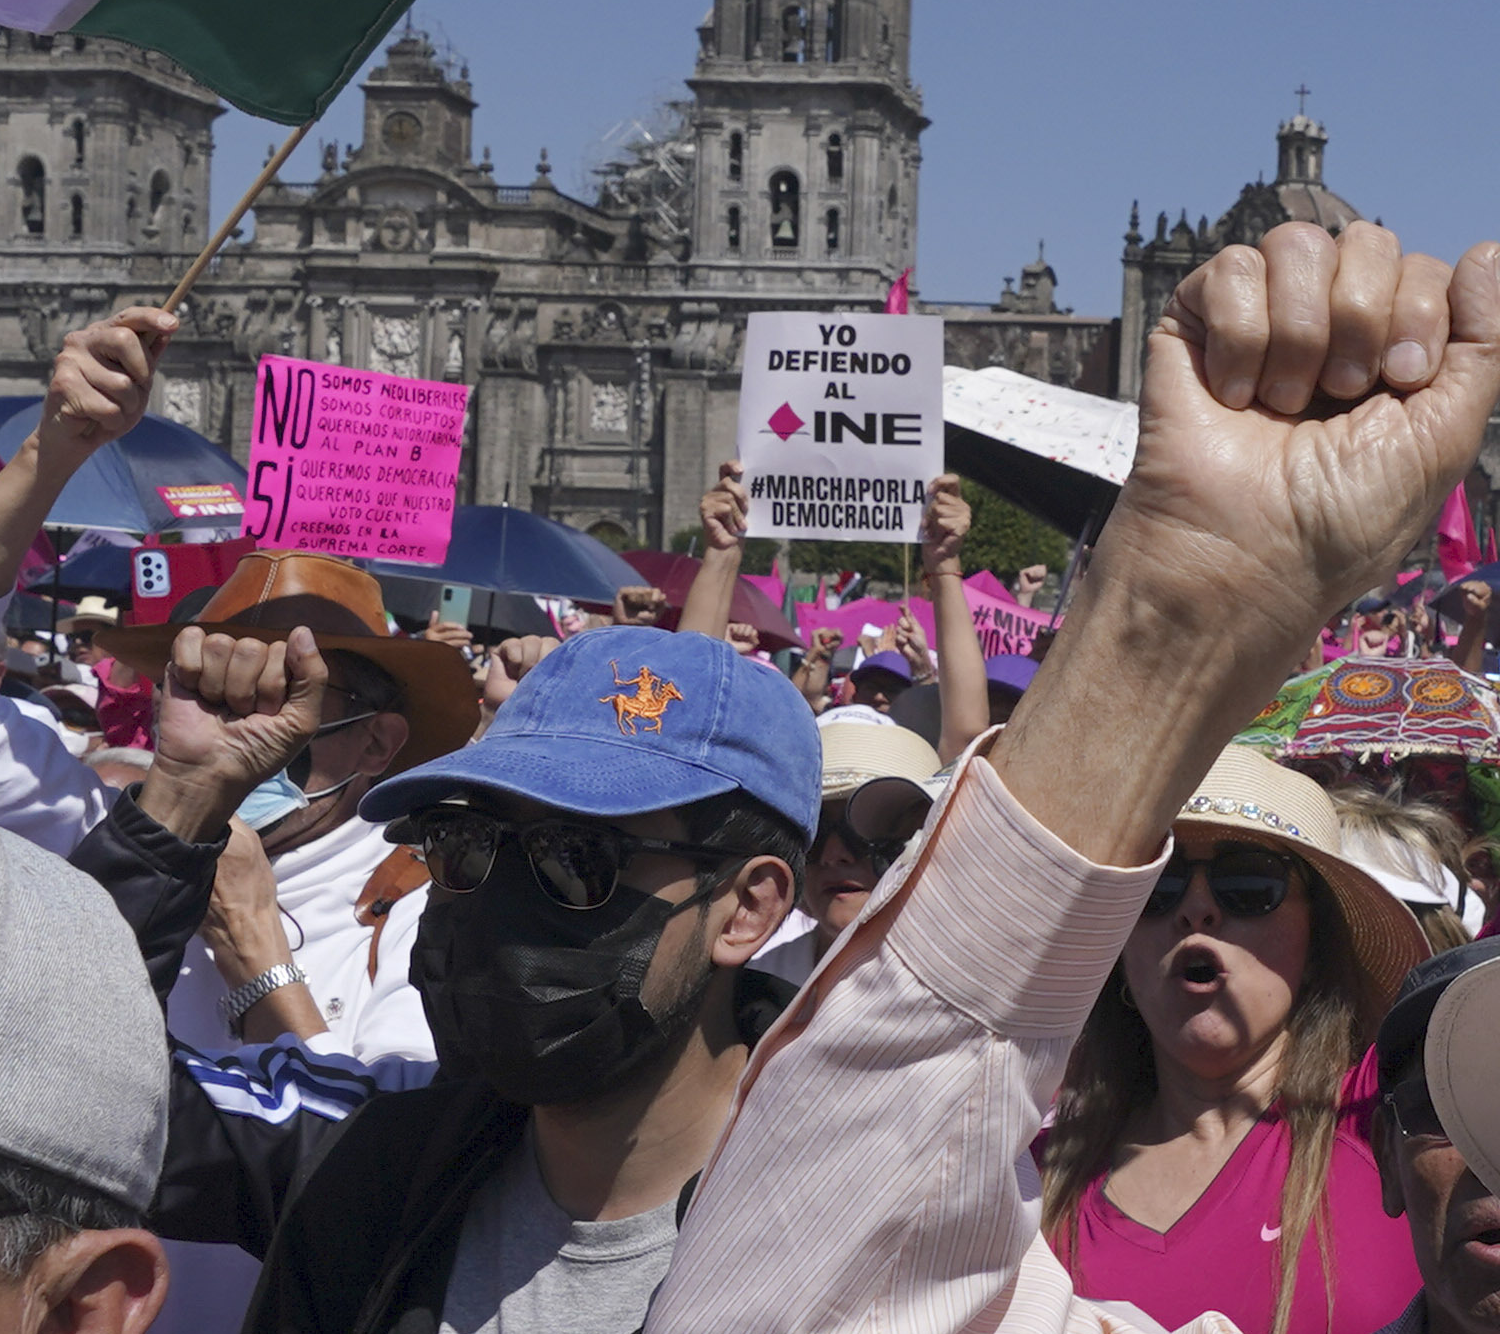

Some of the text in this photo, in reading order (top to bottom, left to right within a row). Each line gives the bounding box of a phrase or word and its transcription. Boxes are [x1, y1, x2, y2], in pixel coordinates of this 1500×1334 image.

[818, 324, 857, 347] YO
[768, 350, 912, 375] DEFIENDO
[322, 373, 467, 412] SOMOS NEOLIBERALES
[824, 382, 856, 400] AL
[259, 364, 316, 449] NO
[320, 396, 457, 430] SOMOS CORRUPTOS
[317, 417, 388, 438] QUEREMOS
[814, 411, 922, 446] INE
[319, 436, 340, 452] AL
[353, 440, 398, 458] PLAN
[301, 460, 458, 489] QUEREMOS DEMOCRACIA
[296, 484, 451, 512] QUEREMOS QUE NUESTRO
[750, 475, 926, 505] #MARCHAPORLA
[328, 505, 362, 520] VOTO
[772, 501, 904, 531] DEMOCRACIA
[290, 521, 351, 536] CREEMOS
[294, 537, 369, 553] SUPREMA
[972, 605, 1041, 637] #MIV
